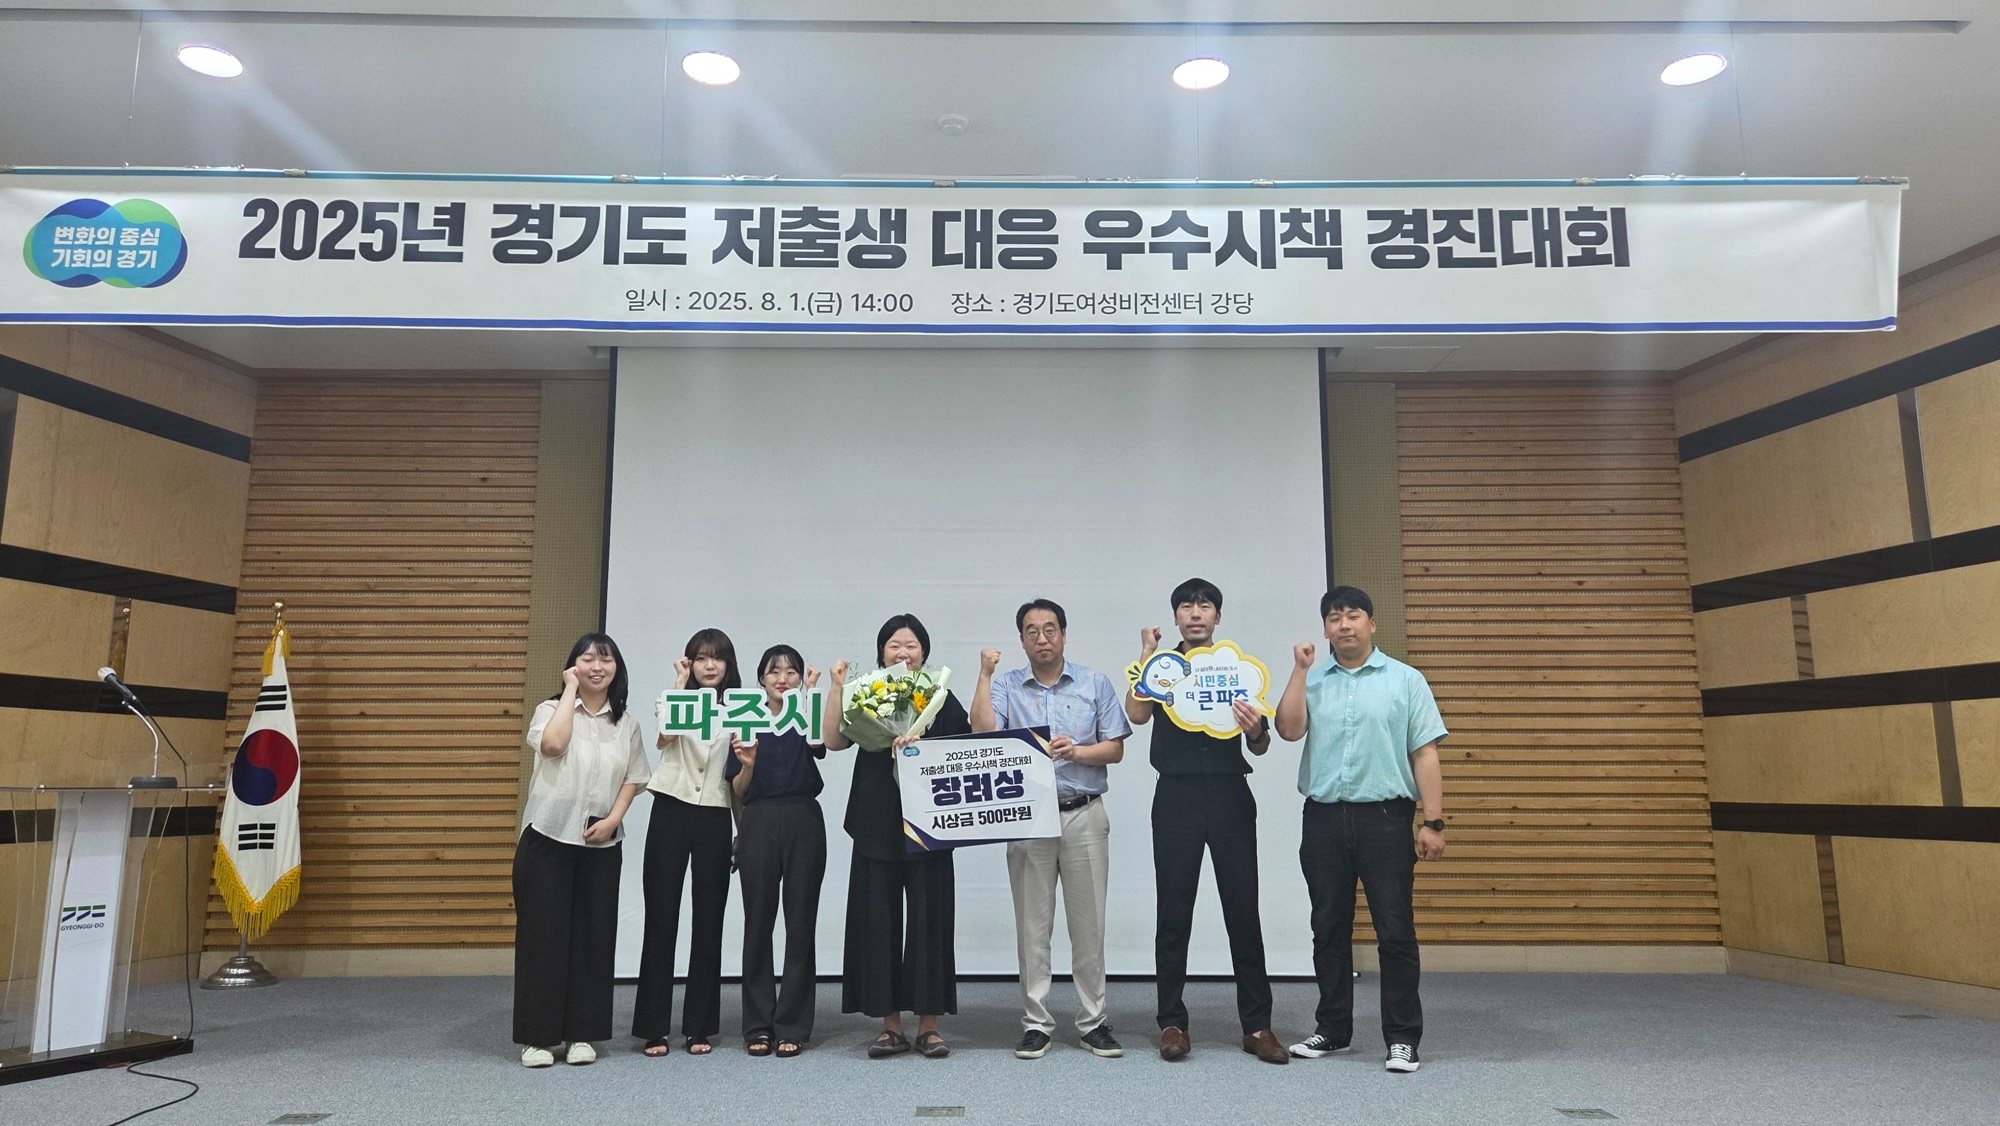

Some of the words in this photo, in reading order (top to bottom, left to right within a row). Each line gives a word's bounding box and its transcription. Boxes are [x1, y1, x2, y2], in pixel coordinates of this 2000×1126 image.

[53, 226, 116, 245] 변화의
[120, 228, 160, 246] 중심
[239, 198, 466, 262] 2025년
[491, 204, 687, 265] 경기도
[712, 206, 907, 269] 저출생
[932, 208, 1058, 270] 대응
[1083, 208, 1343, 270] 우수시책
[1367, 206, 1630, 269] 경진대회
[51, 249, 112, 268] 기회의
[117, 250, 157, 268] 경기
[625, 288, 667, 312] 일시
[688, 291, 753, 311] 2025.
[761, 292, 782, 312] 8.
[789, 291, 843, 316] 1.(금)
[850, 293, 914, 312] 14:00
[950, 291, 993, 315] 장소
[1012, 292, 1203, 315] 경기도여성비전센터
[1210, 292, 1254, 315] 강당
[1186, 692, 1195, 701] 더
[665, 693, 821, 742] 파주시
[945, 749, 978, 761] 2025년
[979, 746, 1004, 758] 경기도
[920, 764, 945, 776] 저출생
[946, 763, 963, 773] 대응
[964, 759, 998, 771] 우수시책
[998, 755, 1032, 768] 경진대회
[931, 769, 1025, 806] 장려상
[932, 812, 974, 830] 시상금
[978, 805, 1032, 825] 500만원
[60, 922, 105, 931] GYEONGGI-DO
